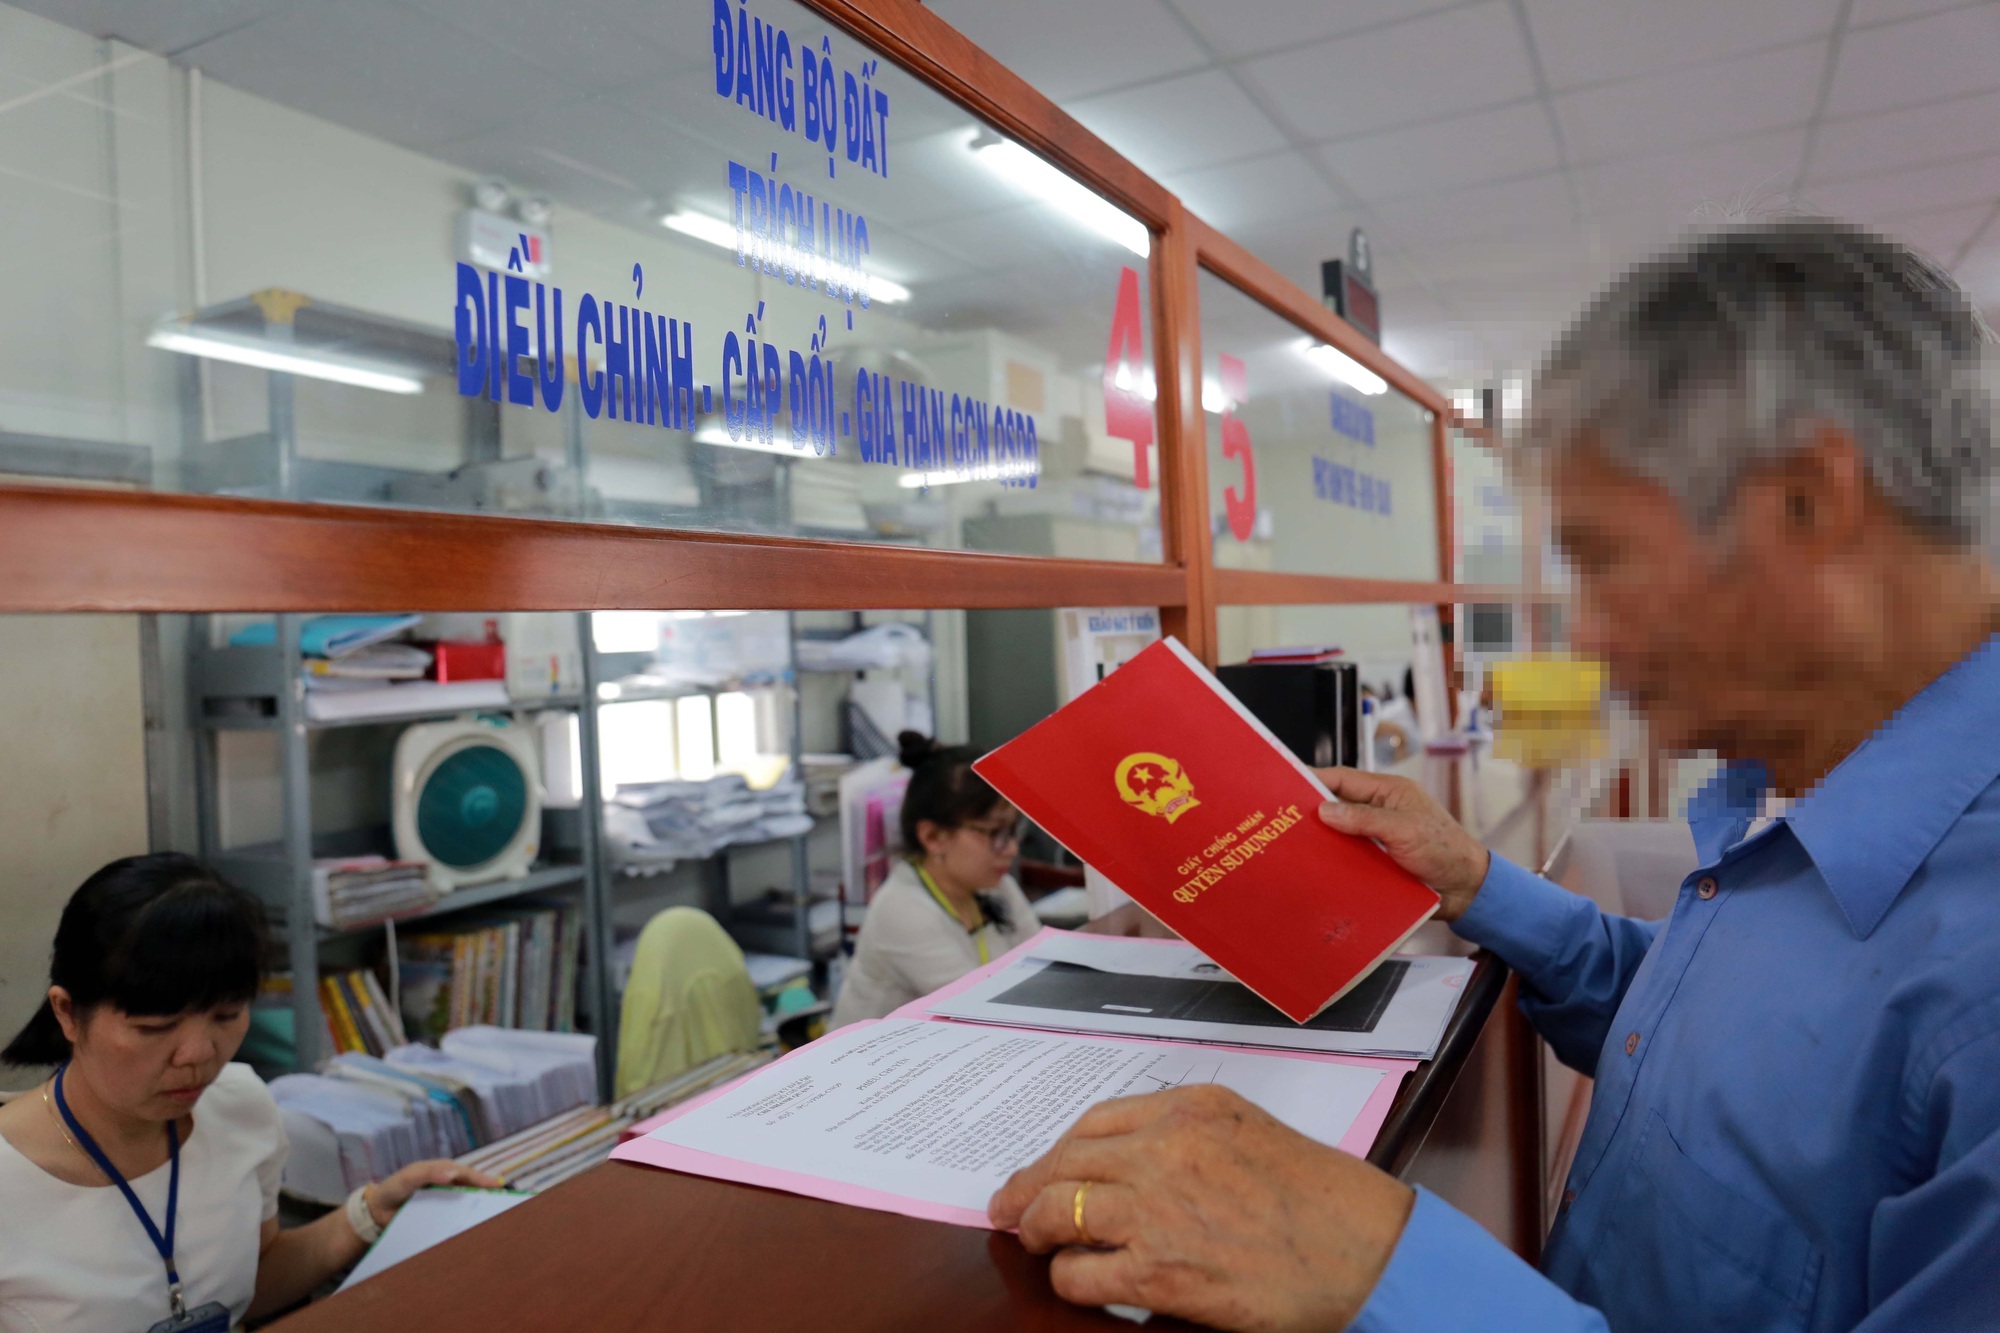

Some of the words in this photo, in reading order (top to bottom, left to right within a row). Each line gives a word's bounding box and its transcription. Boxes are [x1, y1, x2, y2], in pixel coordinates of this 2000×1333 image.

[802, 35, 838, 179] BỘ
[844, 59, 889, 179] ĐẤT
[728, 152, 817, 292] TRÍCH
[455, 234, 564, 413] ĐIỀU
[577, 263, 696, 433] CHỈNH
[722, 301, 782, 445] CẤP
[789, 314, 837, 456] ĐỔI
[856, 367, 898, 466] GIA
[1103, 265, 1154, 490] 4
[1220, 353, 1257, 543] 5
[1173, 863, 1227, 903] QUYỀN
[1235, 825, 1279, 860] DỤNG
[1269, 805, 1303, 834] ĐẤT
[1177, 856, 1202, 875] GIẤY
[1203, 835, 1238, 858] CHỨNG
[1236, 810, 1265, 834] NHẬN
